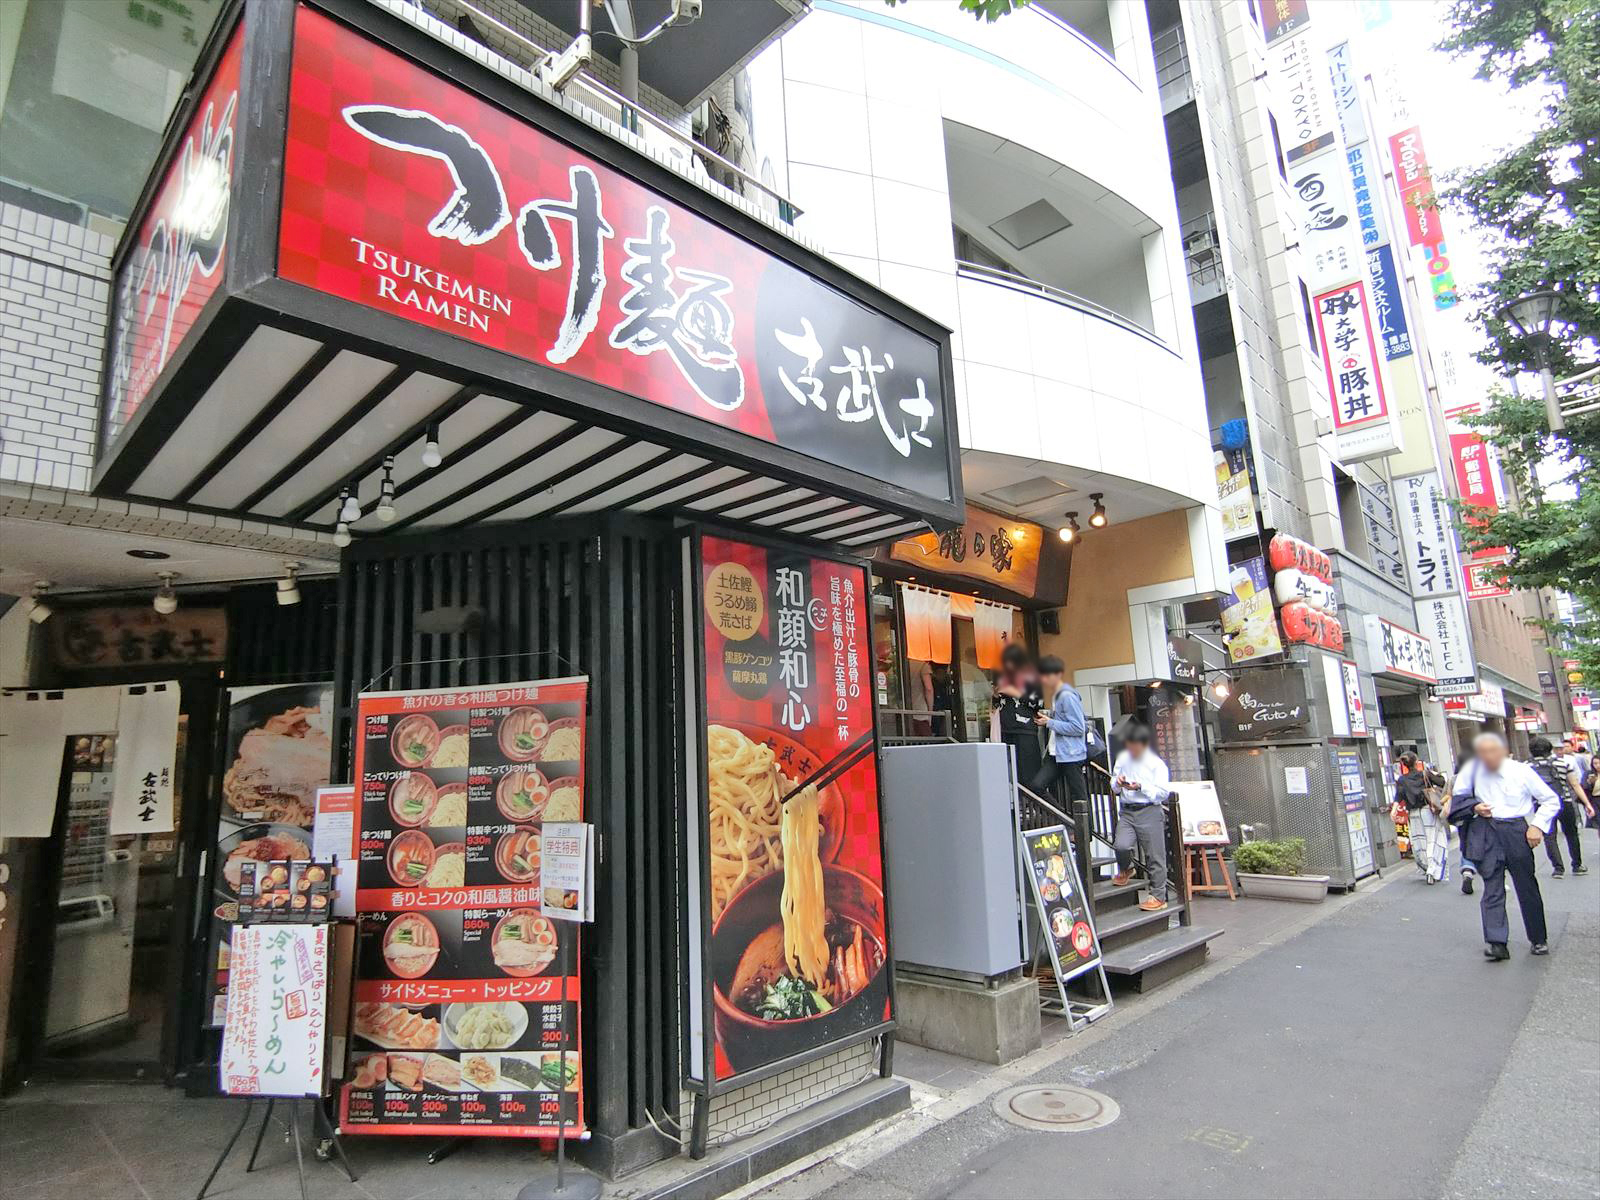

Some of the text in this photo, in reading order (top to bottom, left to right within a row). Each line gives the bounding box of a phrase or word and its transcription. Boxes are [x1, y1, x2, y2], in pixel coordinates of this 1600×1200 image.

[350, 237, 513, 317] TSUKEMEN
[377, 279, 490, 334] RAMEN
[1338, 366, 1374, 420] 豚丼
[1464, 459, 1485, 497] 郵便局
[1416, 541, 1437, 592] トライ
[718, 611, 753, 630] 荒さば
[774, 566, 811, 732] 和顔和心
[842, 577, 860, 699] 魚介出汁と豚骨の
[724, 650, 773, 668] 黒豚ゲンコツ
[829, 575, 850, 742] 旨味を極めた至福の一杯
[402, 687, 540, 710] 魚介の香る和風つけ麺
[1238, 723, 1253, 732] B1F
[363, 770, 411, 782] こってりつけ麺
[468, 763, 537, 776] 特製こってりつけ麺
[138, 771, 158, 822] 古武士
[391, 886, 541, 908] 香りとコクの和風醤油味
[463, 908, 514, 920] 特製らーめん
[379, 979, 553, 999] サイドメニュー・トッピング
[460, 1101, 487, 1113] 100円
[499, 1101, 526, 1113] 100円
